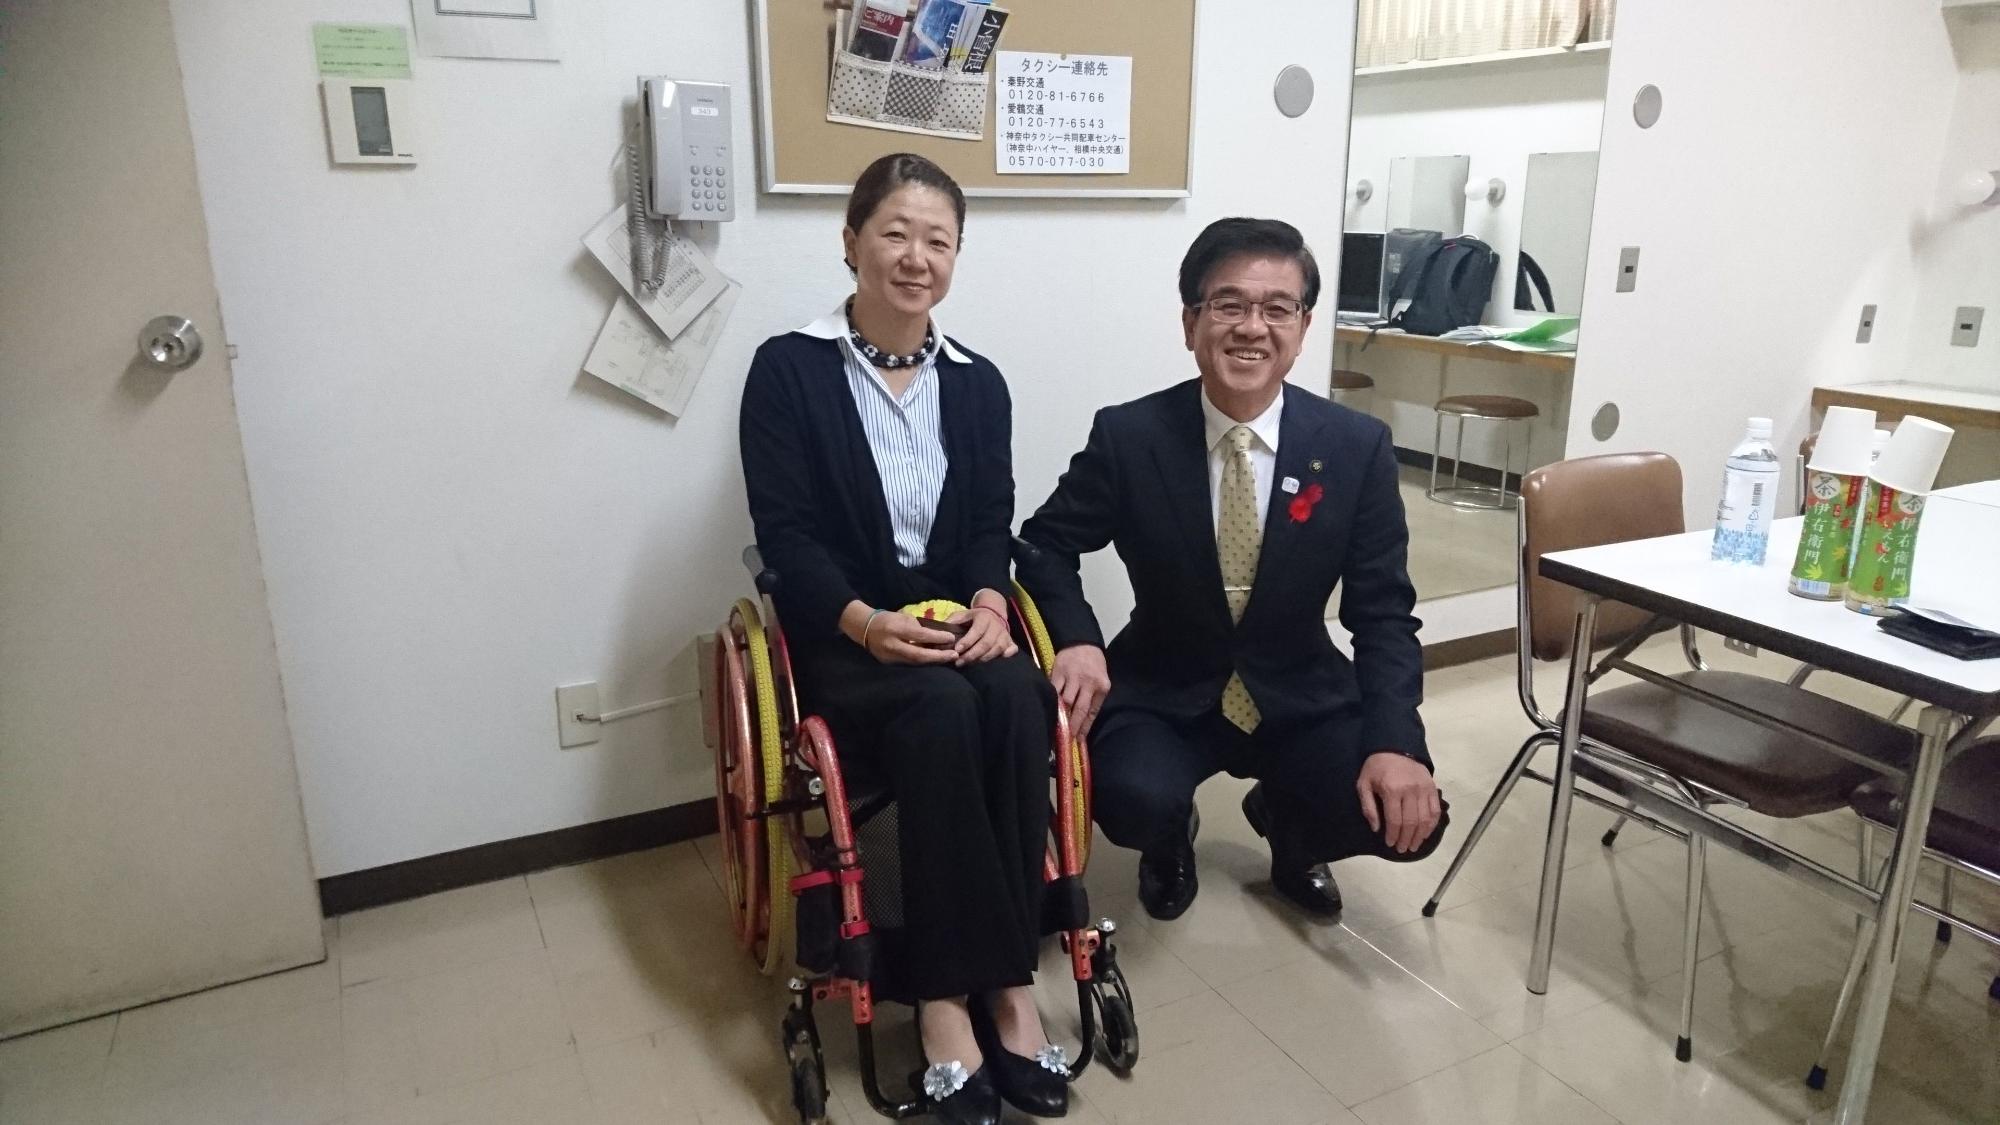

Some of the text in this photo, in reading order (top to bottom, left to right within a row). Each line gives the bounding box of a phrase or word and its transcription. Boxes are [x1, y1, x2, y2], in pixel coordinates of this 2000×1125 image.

[1021, 58, 1109, 76] タクシー連絡先
[1008, 89, 1105, 103] 0120-81-6766
[1008, 116, 1105, 129] 0120-77-6543
[1008, 155, 1105, 167] 0570-077-030
[1814, 475, 1837, 497] 茶
[1803, 501, 1832, 565] 伊右衛門
[1890, 517, 1917, 581] 伊右衛門
